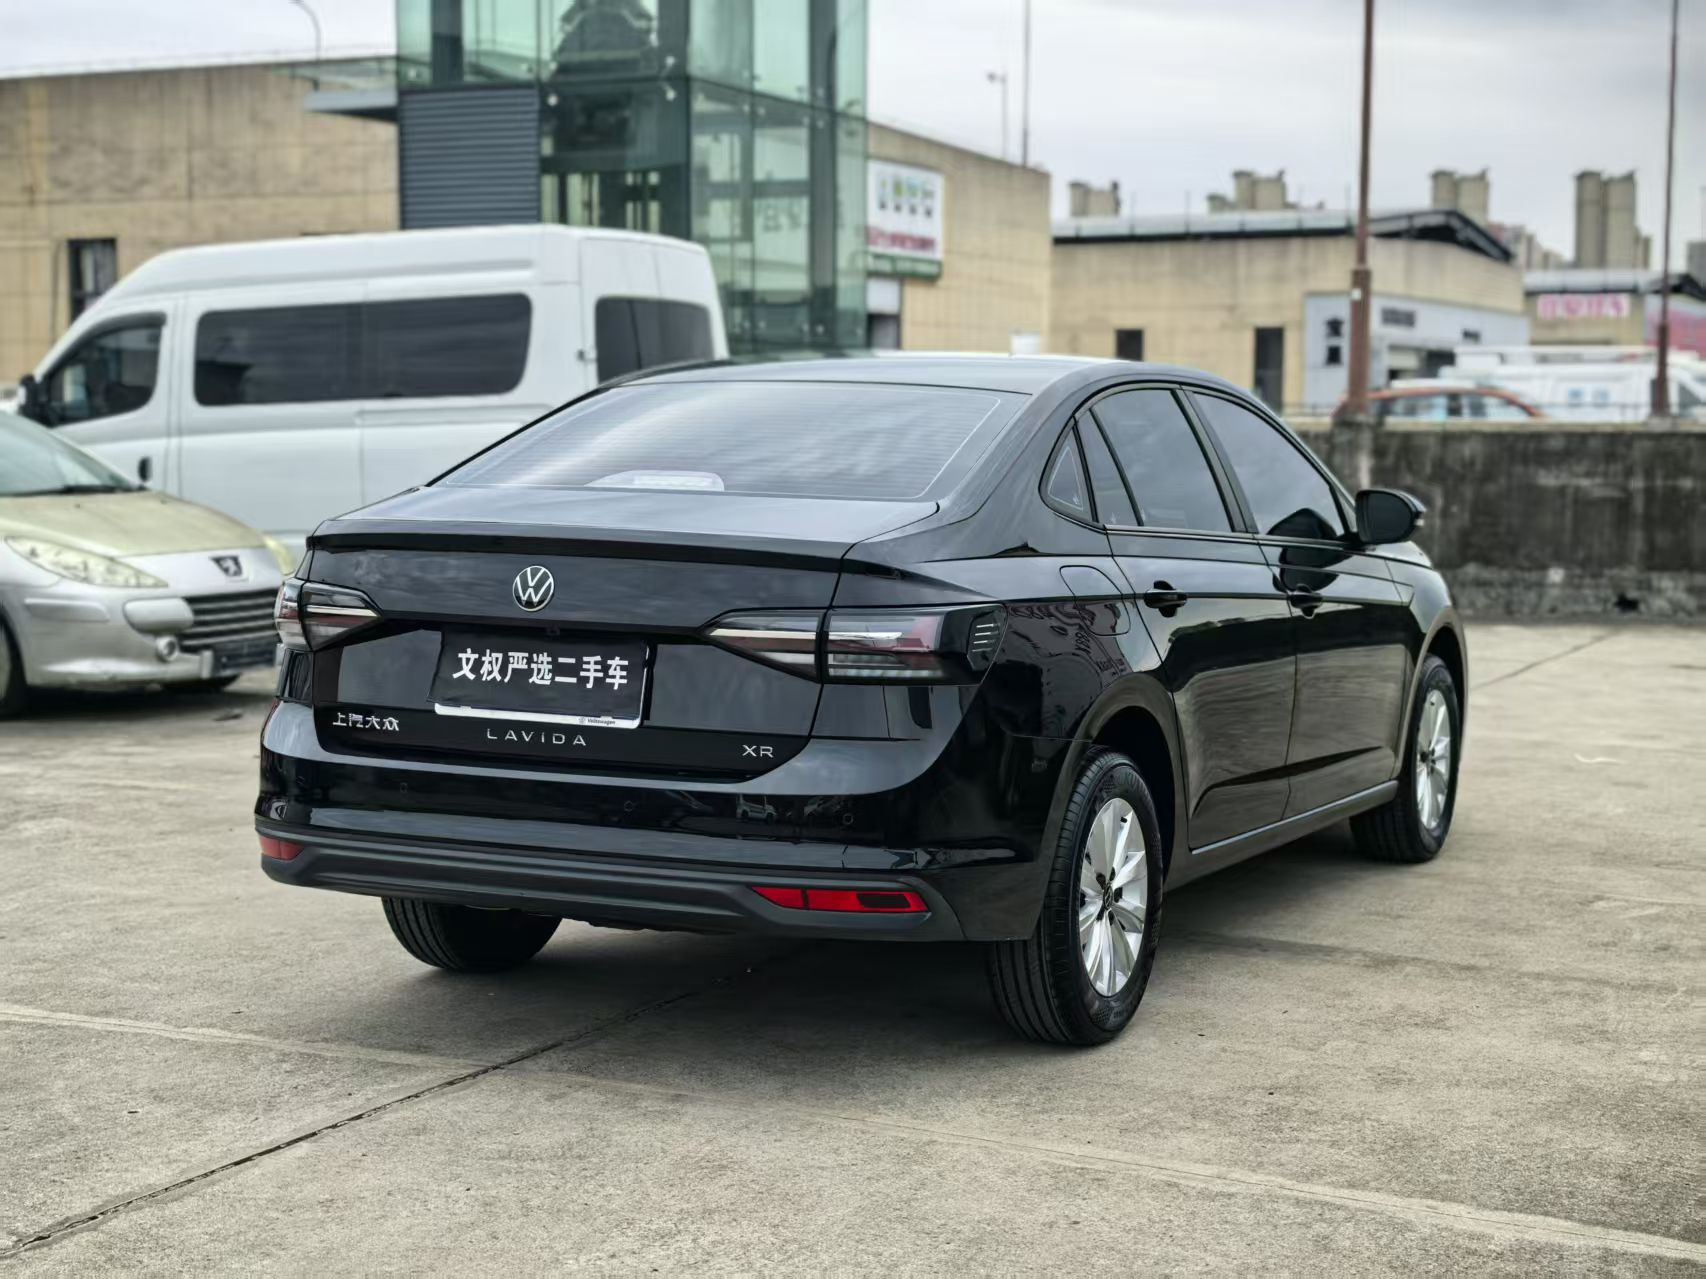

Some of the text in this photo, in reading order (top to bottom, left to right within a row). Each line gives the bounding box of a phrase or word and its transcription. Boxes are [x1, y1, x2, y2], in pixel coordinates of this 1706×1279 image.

[452, 647, 629, 691] 文权严选二手车
[332, 712, 400, 731] 上汽大众
[486, 728, 587, 746] LAVIDA
[741, 744, 774, 758] XR
